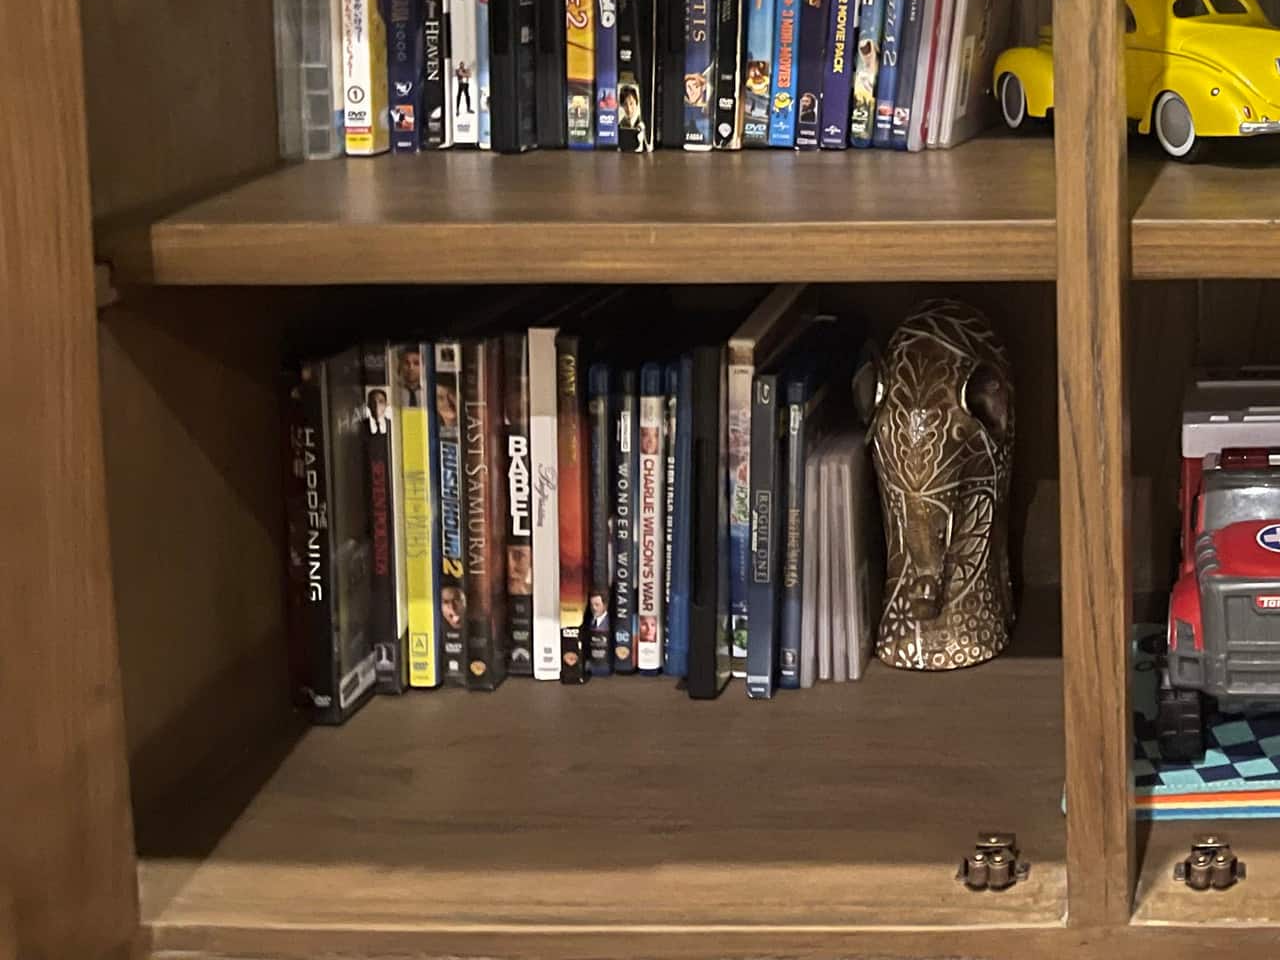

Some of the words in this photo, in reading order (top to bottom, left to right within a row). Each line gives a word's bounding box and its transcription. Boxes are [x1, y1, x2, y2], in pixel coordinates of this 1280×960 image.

[566, 10, 589, 30] 2
[833, 4, 848, 41] MOVIE
[425, 20, 440, 81] HEAVEN
[831, 41, 846, 74] PACK
[465, 400, 488, 456] LAST
[440, 441, 460, 499] RUSH
[508, 435, 531, 536] BABEL
[642, 458, 655, 514] CHARLIE
[465, 463, 488, 576] SAMURAI
[617, 463, 629, 539] WONDER
[758, 494, 769, 544] ROGUE
[442, 500, 462, 559] HOUR
[642, 516, 655, 579] WILSON'S
[443, 557, 464, 579] 2
[617, 552, 629, 619] WOMAN
[757, 548, 768, 578] ONE
[641, 581, 655, 612] WAR
